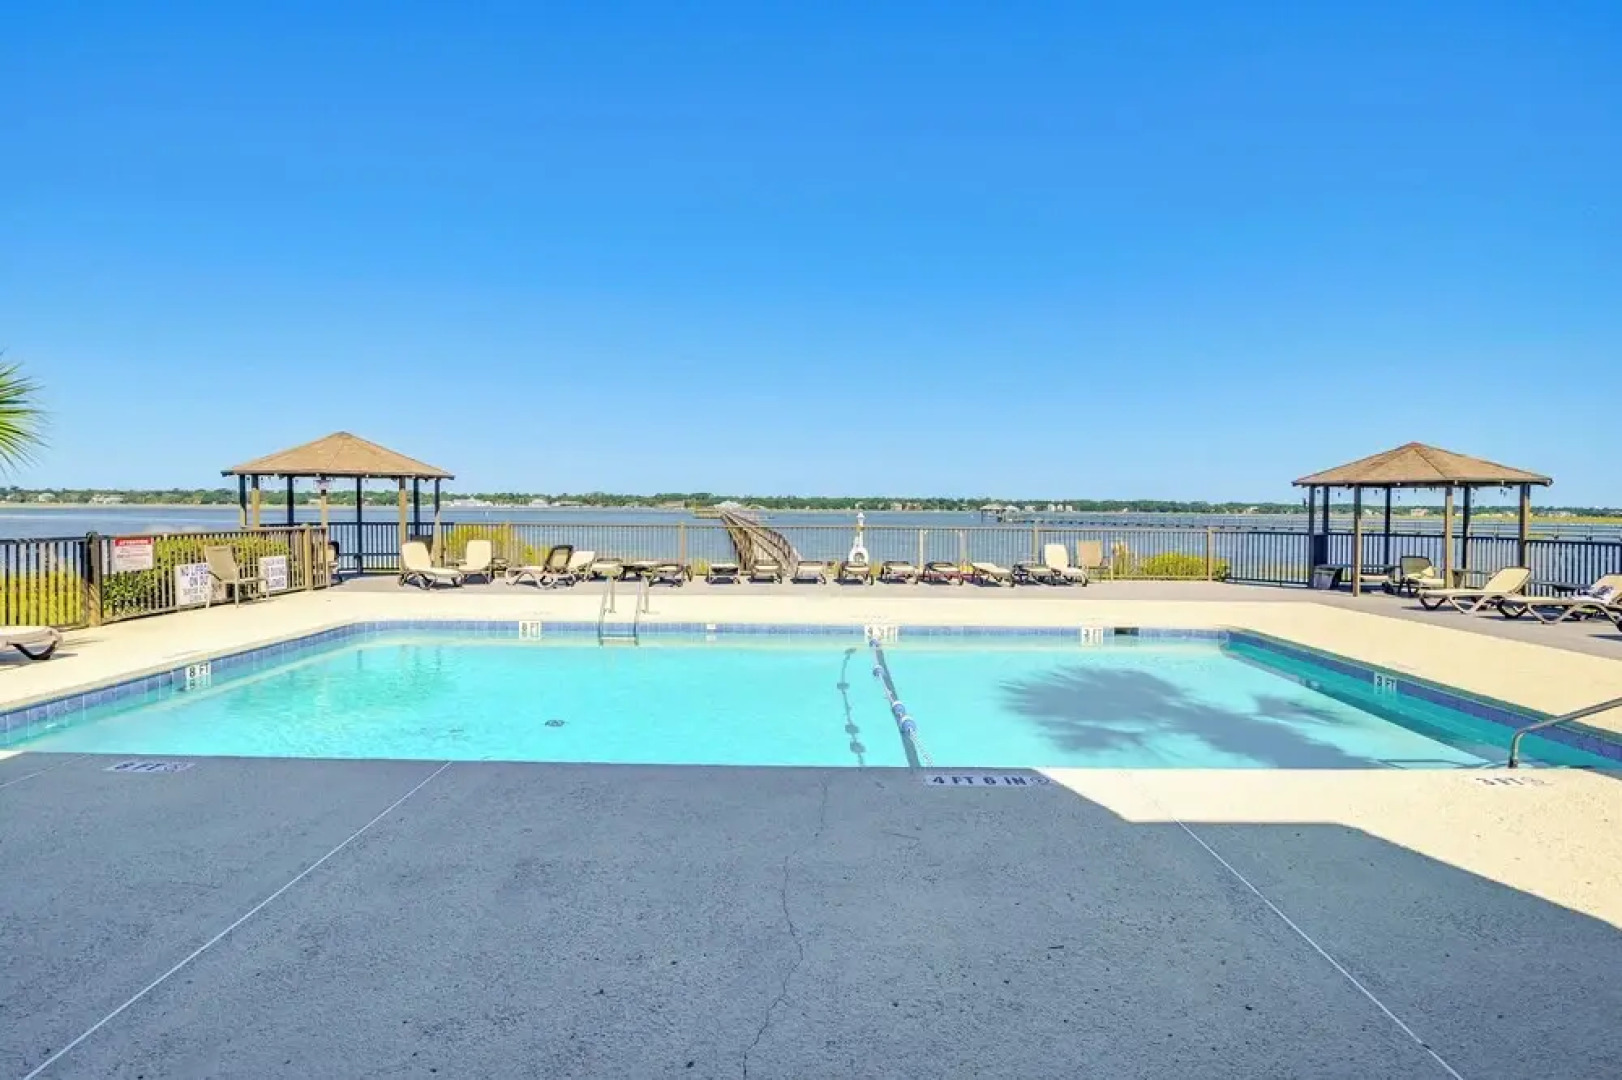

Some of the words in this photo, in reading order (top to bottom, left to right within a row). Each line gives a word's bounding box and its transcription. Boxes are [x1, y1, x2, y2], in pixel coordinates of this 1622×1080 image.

[189, 666, 196, 677] 8
[199, 662, 209, 675] FT
[1376, 675, 1383, 687] 3
[1385, 677, 1396, 690] FT
[932, 776, 945, 784] 4
[951, 776, 974, 784] FT
[982, 776, 997, 785] 6
[1003, 776, 1027, 785] IN
